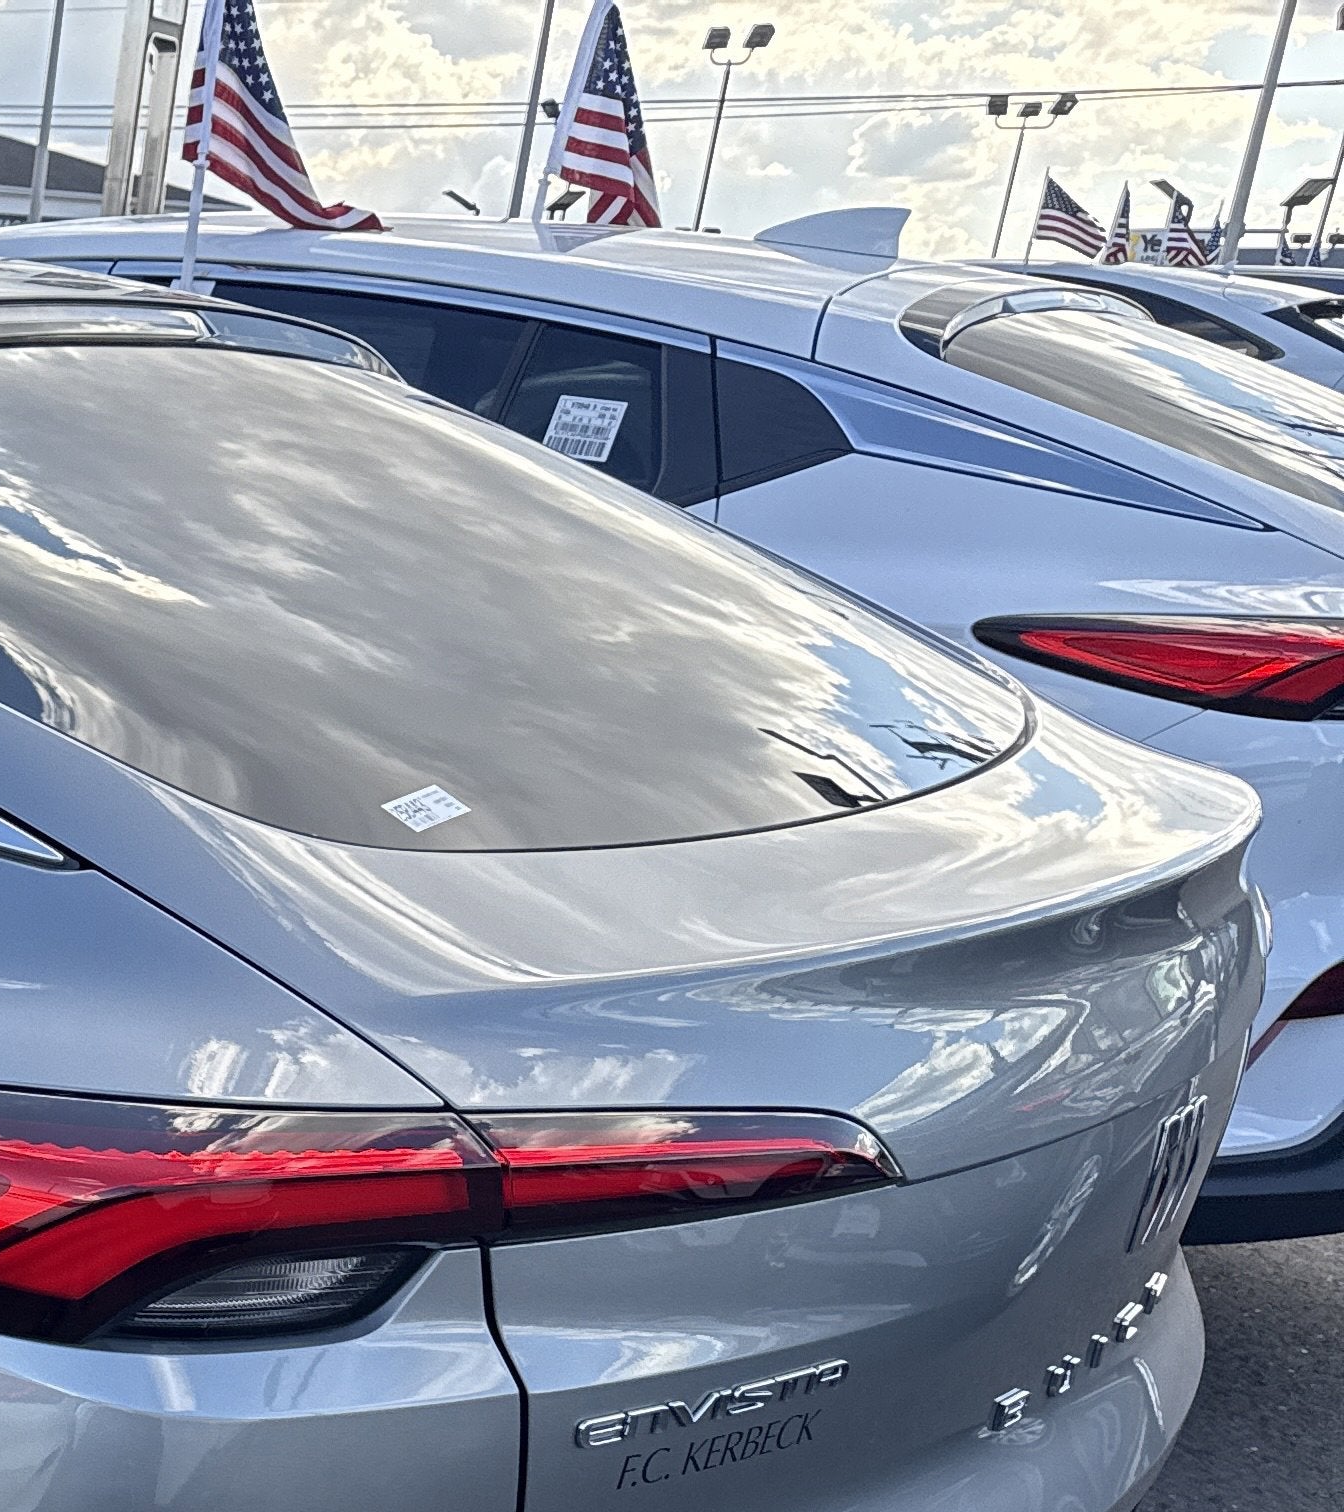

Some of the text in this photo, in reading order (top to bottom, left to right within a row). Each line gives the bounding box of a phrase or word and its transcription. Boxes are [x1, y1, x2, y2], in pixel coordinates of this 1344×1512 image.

[988, 1271, 1169, 1433] BUICK
[573, 1356, 851, 1450] ENVISTA
[616, 1408, 824, 1490] F.C. KERBECK
